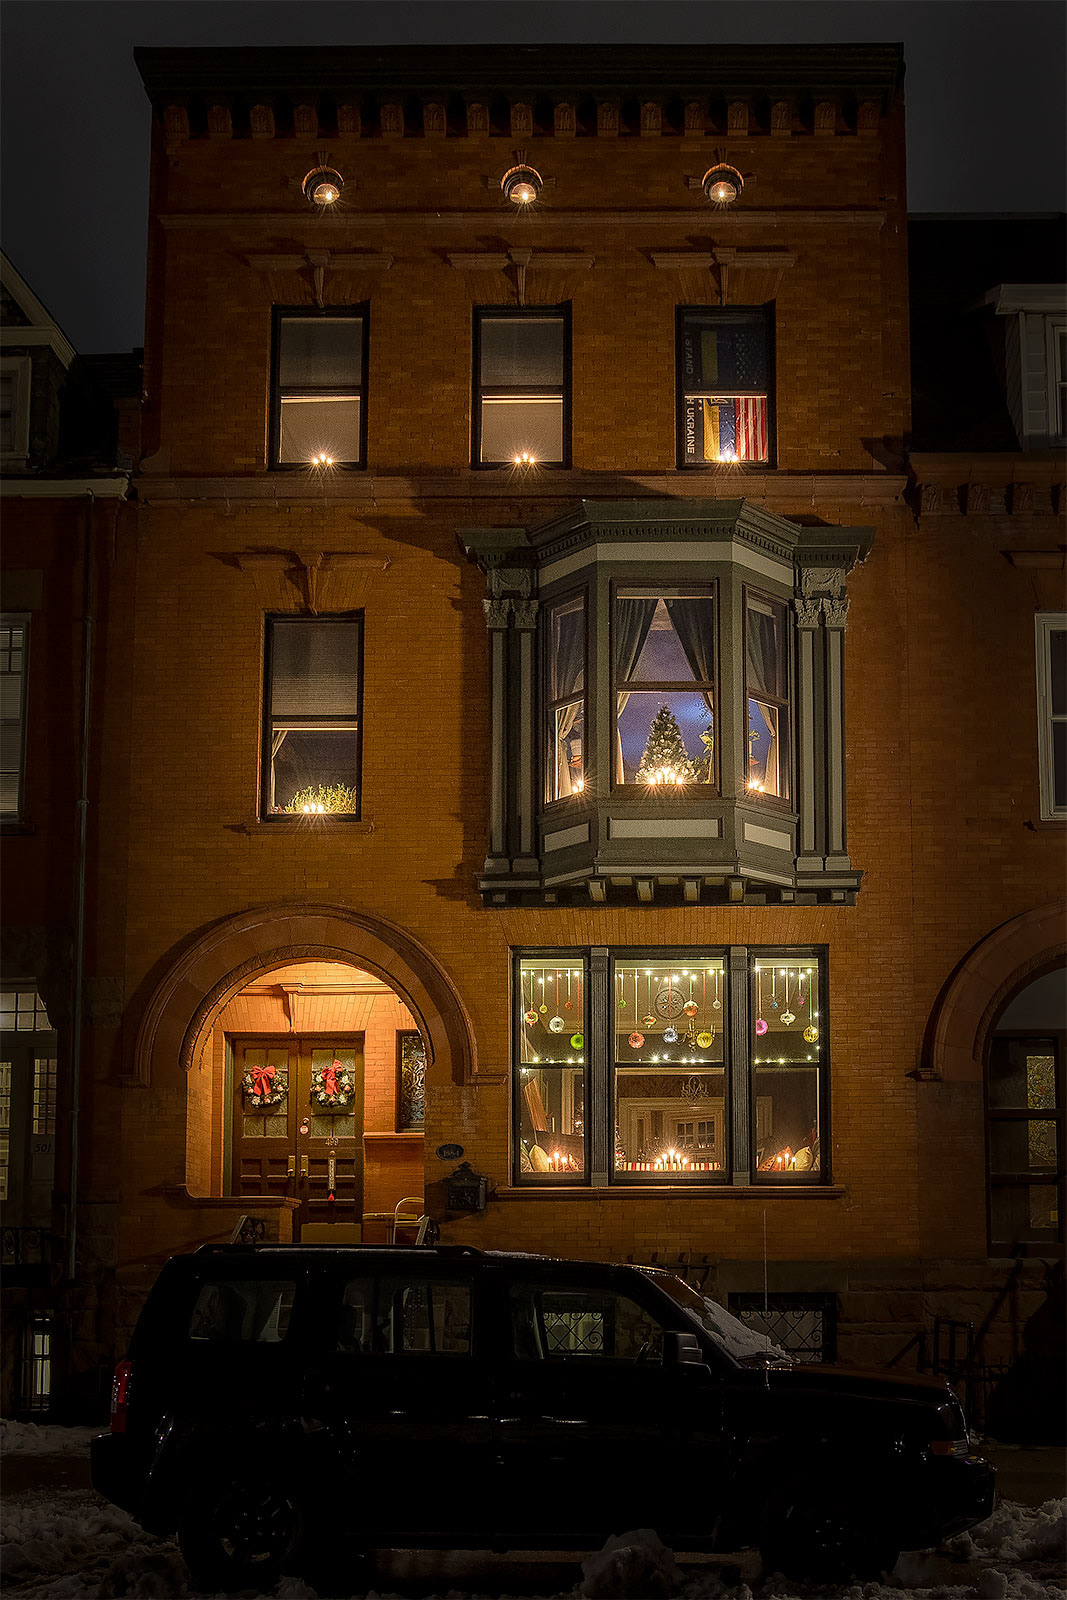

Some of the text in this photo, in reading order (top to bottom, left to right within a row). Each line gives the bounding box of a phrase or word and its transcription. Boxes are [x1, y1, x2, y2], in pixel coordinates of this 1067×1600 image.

[685, 338, 693, 375] STAND
[687, 407, 695, 454] UKRAINE
[34, 1143, 51, 1152] 501
